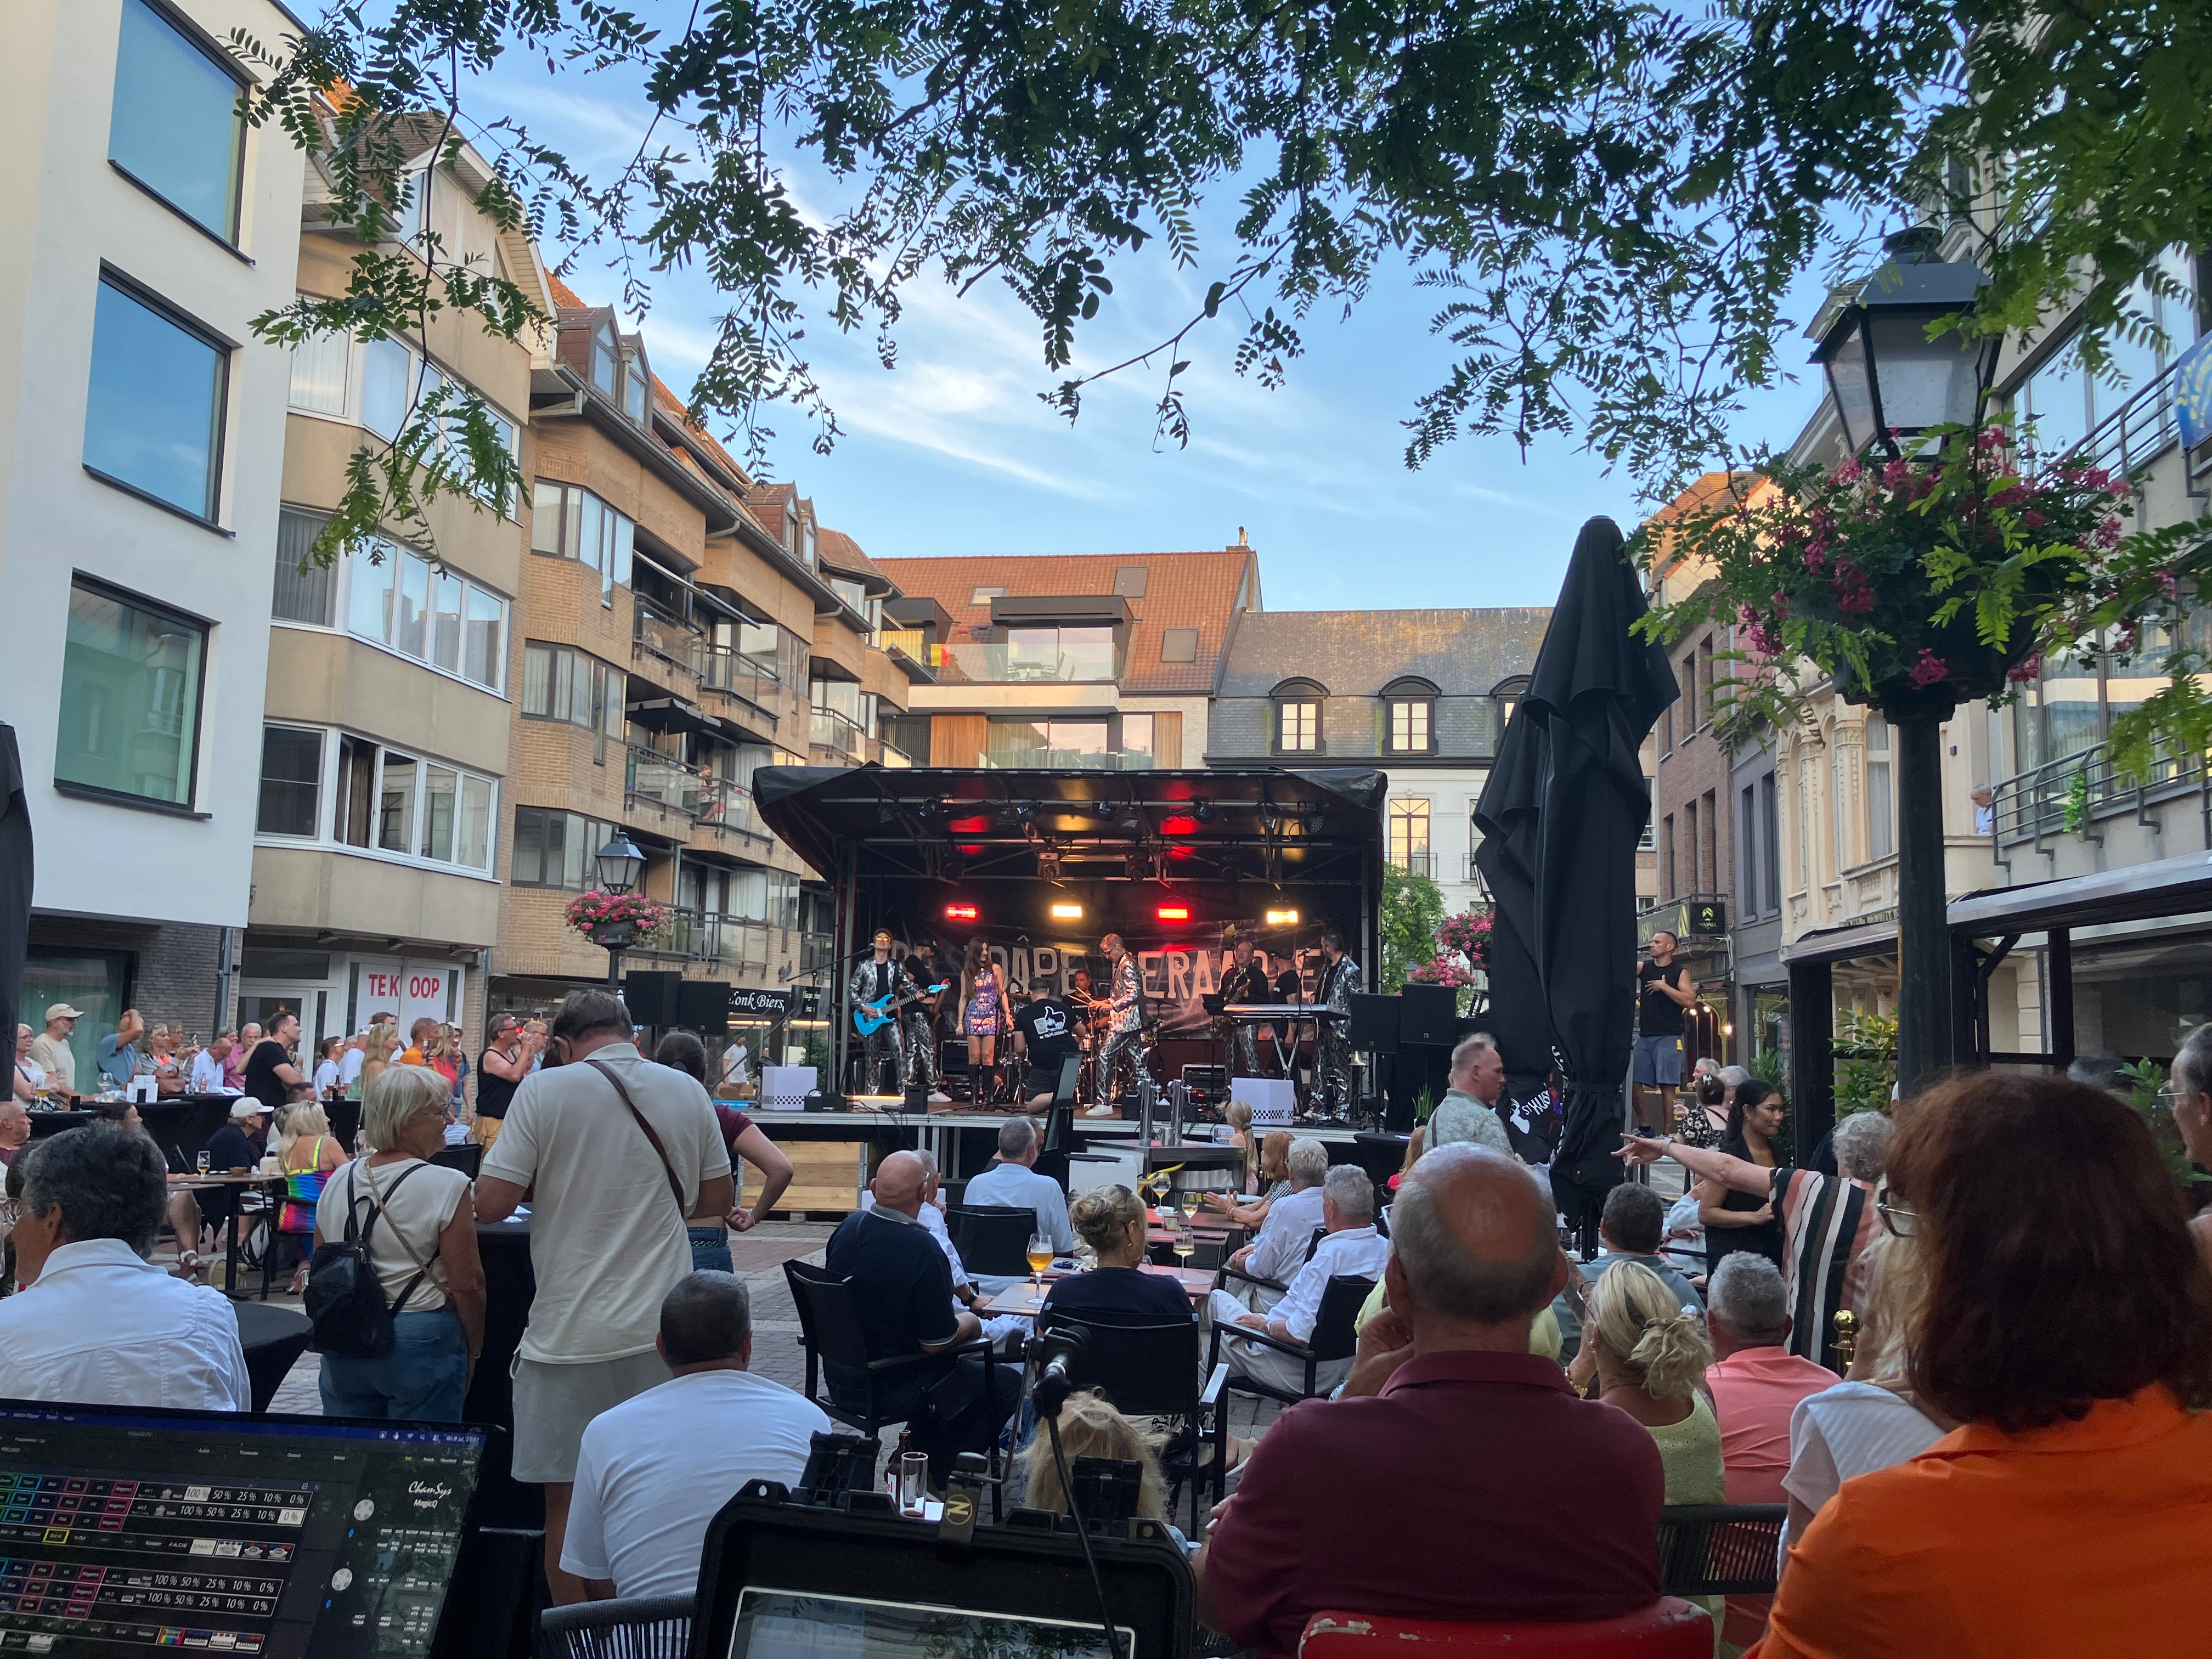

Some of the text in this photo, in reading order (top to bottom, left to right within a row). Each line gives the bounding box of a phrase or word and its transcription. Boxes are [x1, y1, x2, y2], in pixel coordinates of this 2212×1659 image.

[369, 974, 387, 996] TE
[408, 1481, 452, 1499] ChamSys
[414, 1499, 438, 1509] MagicQ
